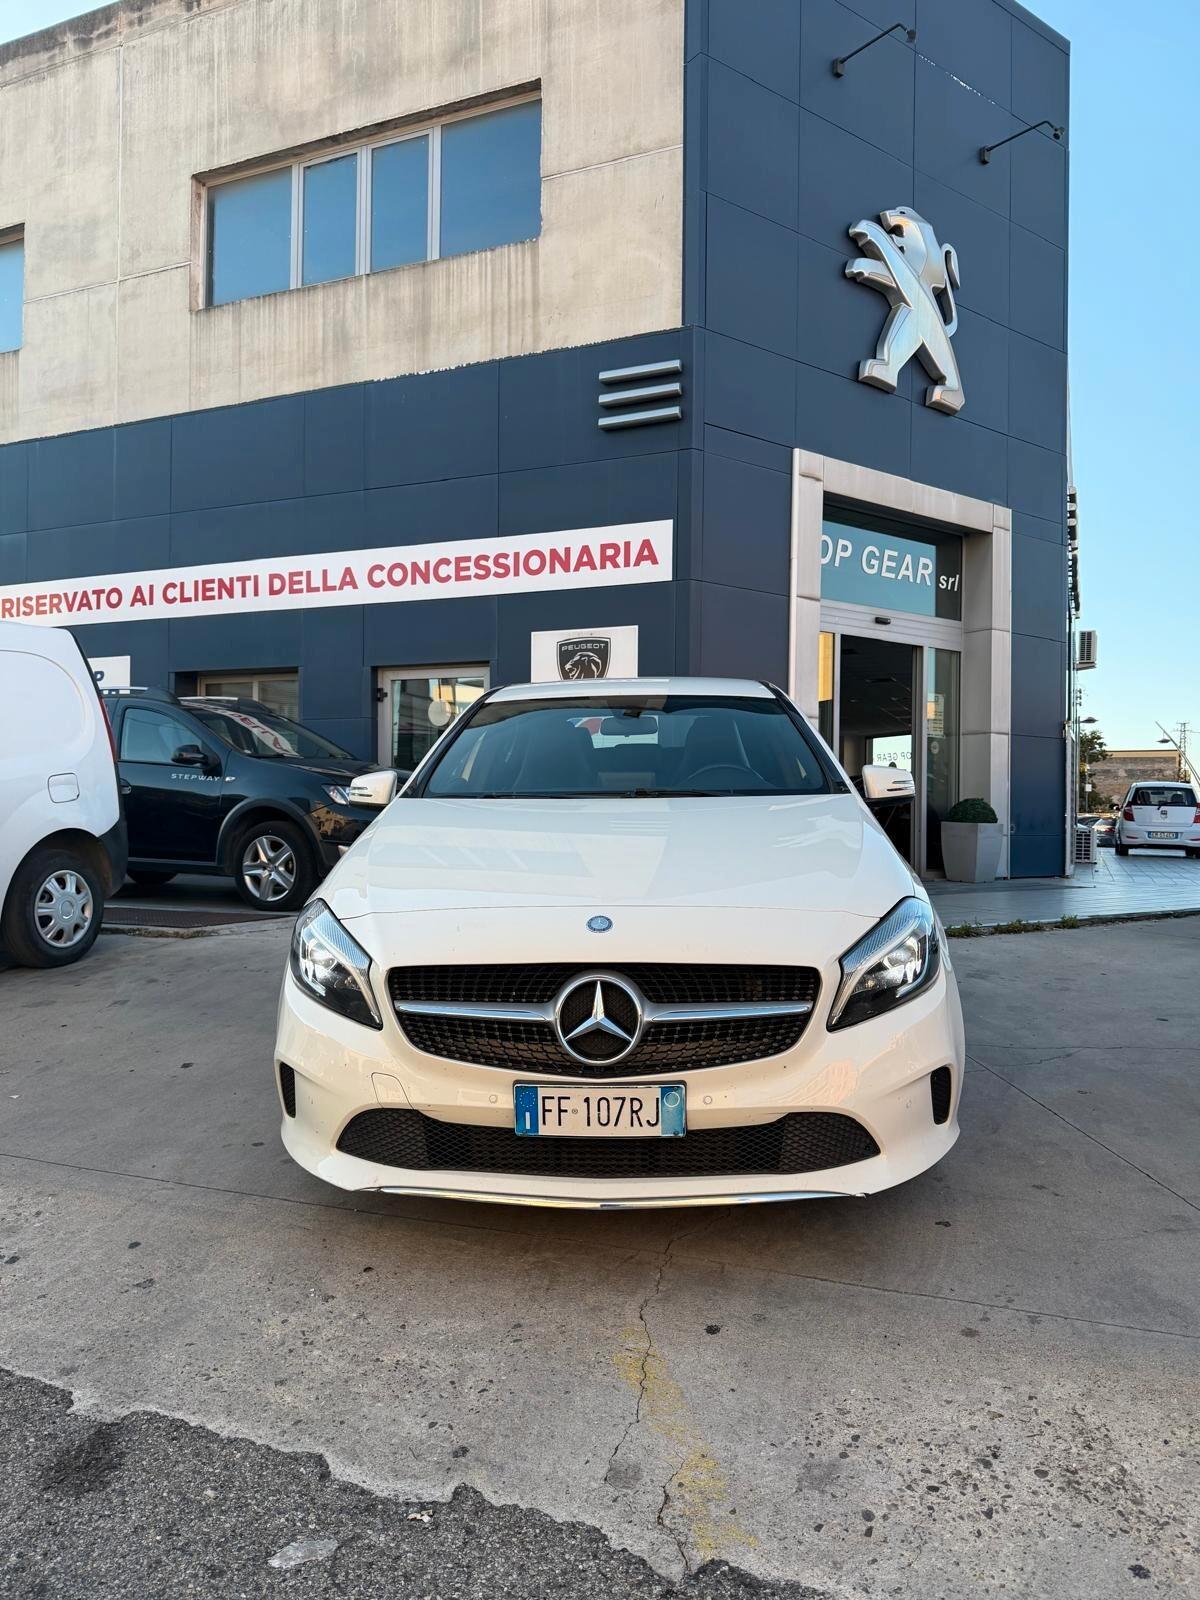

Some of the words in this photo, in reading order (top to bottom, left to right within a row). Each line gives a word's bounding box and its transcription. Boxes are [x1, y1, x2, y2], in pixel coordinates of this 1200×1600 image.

[2, 587, 122, 618] RISERVATO
[130, 584, 154, 607] AI
[162, 575, 259, 605] CLIENTI
[268, 566, 358, 596] DELLA
[367, 539, 659, 588] CONCESSIONARIA
[862, 545, 933, 586] GEAR
[939, 575, 959, 591] srl
[561, 643, 605, 651] PEUGEOT
[170, 773, 220, 781] STEPWAY
